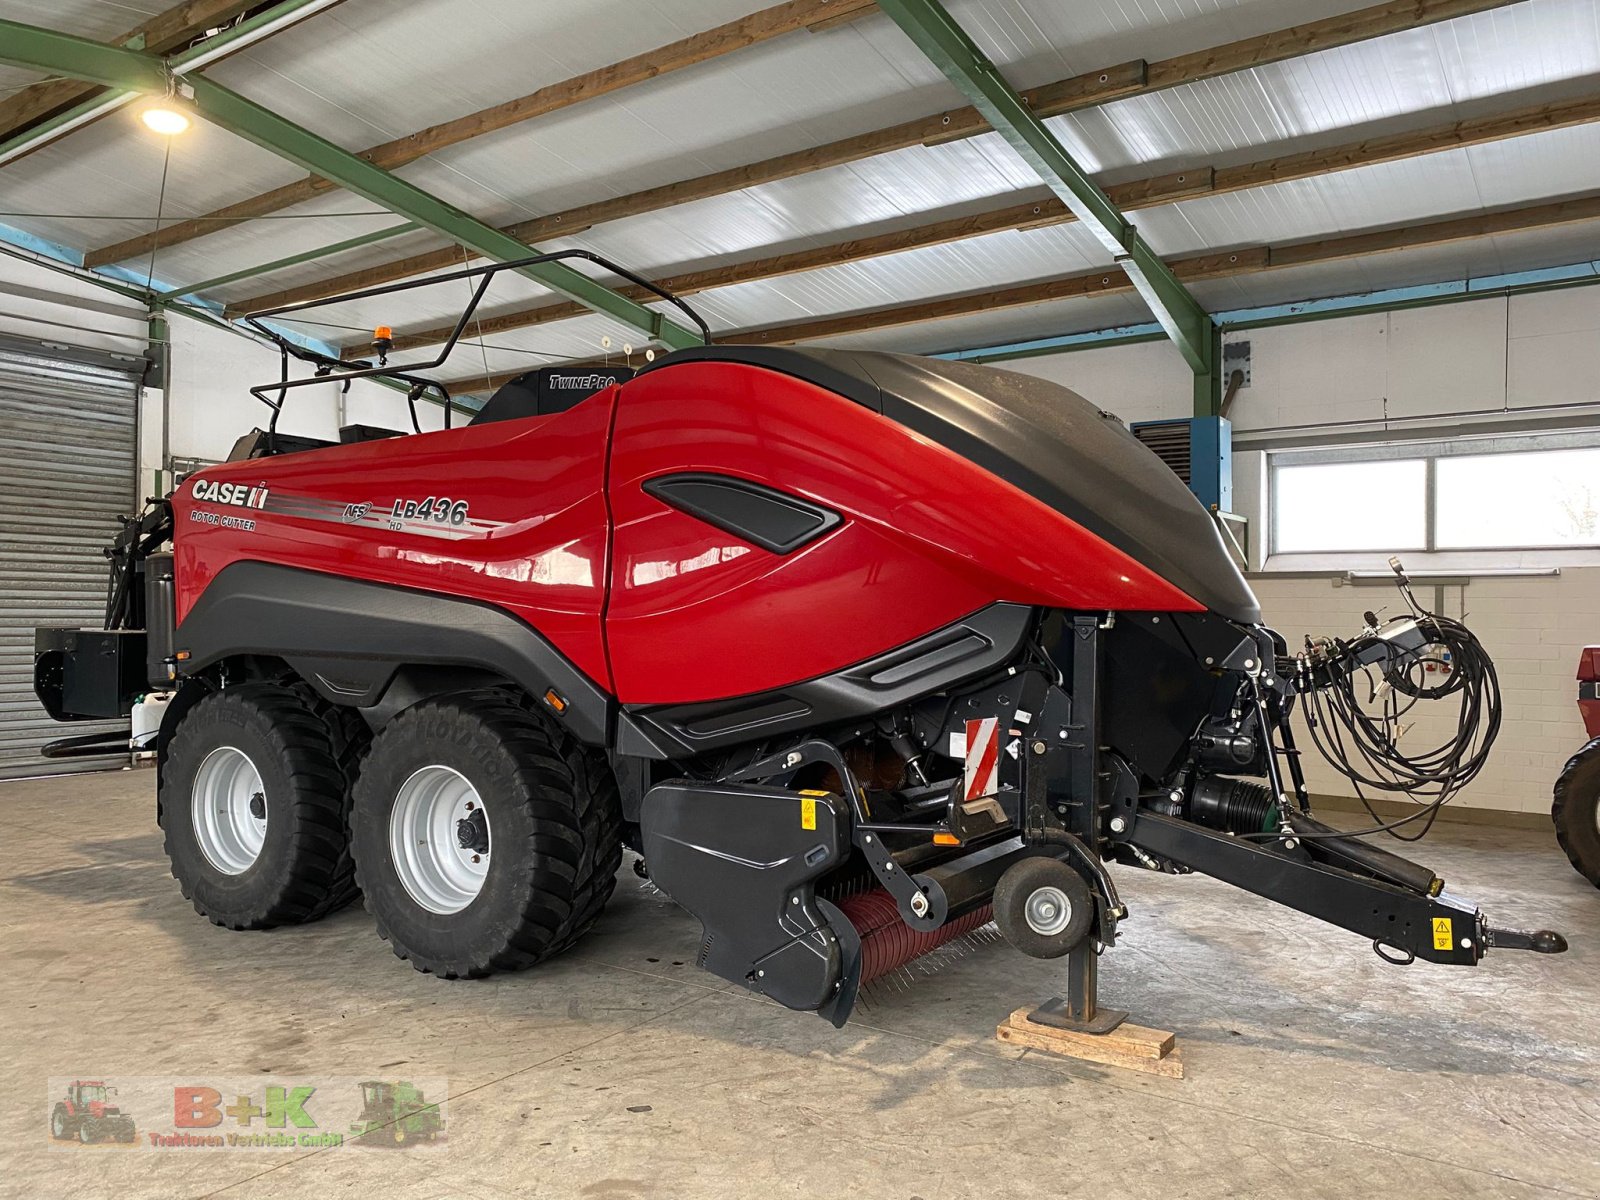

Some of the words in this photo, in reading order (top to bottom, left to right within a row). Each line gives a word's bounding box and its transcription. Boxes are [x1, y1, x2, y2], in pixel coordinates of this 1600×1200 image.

[192, 479, 248, 506] CASE
[190, 510, 220, 525] ROTOR
[220, 515, 256, 531] CUTTER
[342, 503, 368, 518] AFS
[391, 496, 469, 525] LB436
[389, 520, 402, 530] HD
